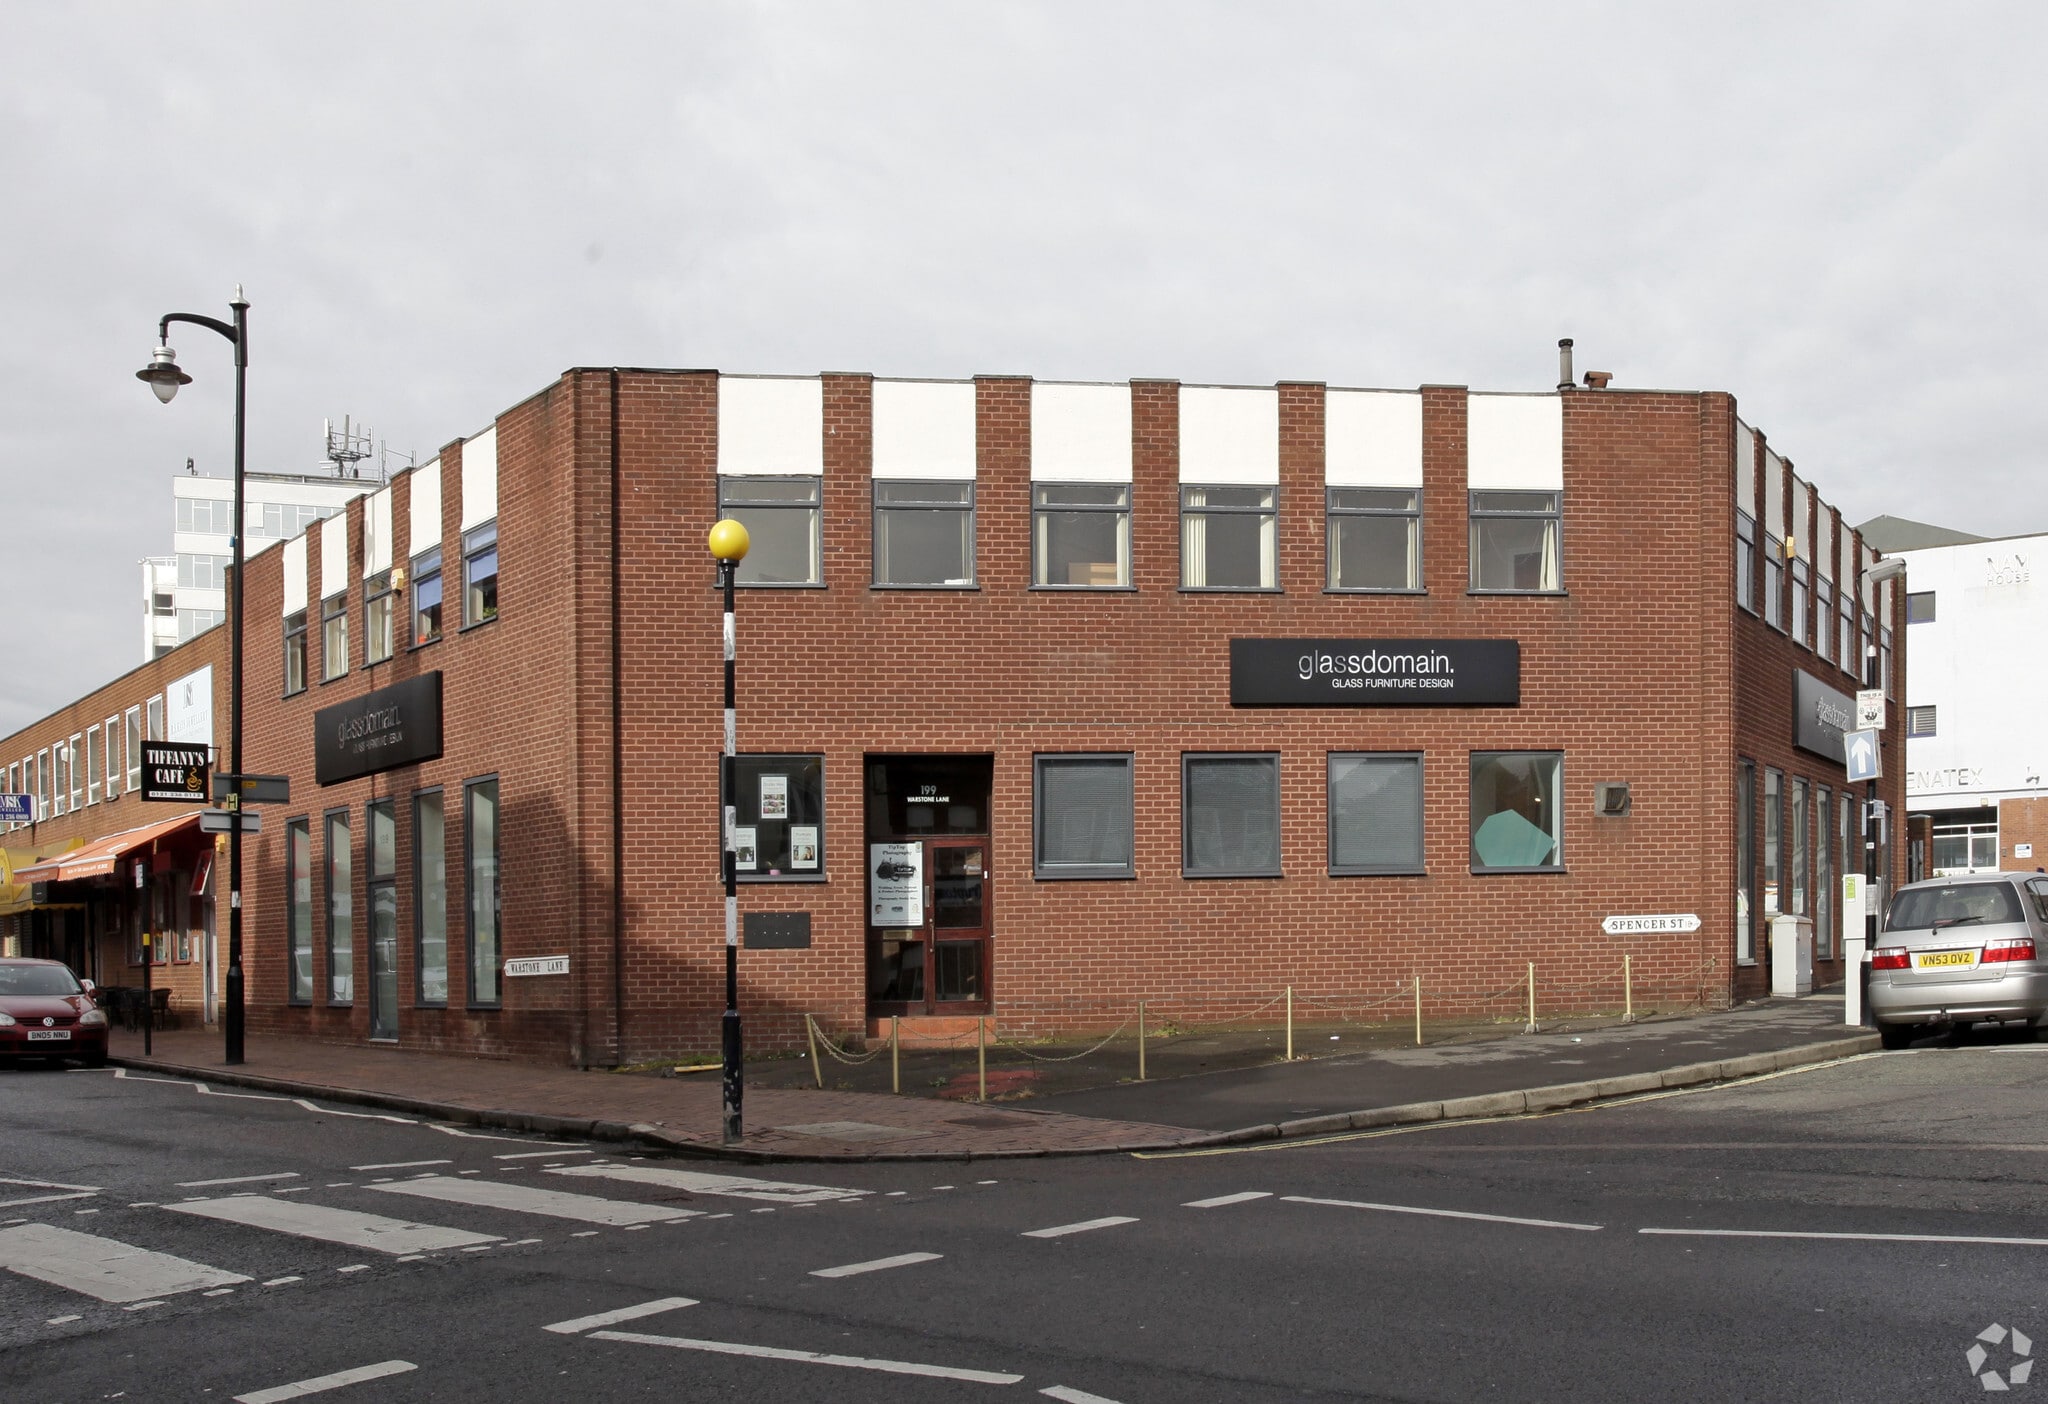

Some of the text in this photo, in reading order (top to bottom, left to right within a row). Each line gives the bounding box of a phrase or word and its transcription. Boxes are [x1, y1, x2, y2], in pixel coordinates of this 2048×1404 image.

[1987, 573, 2029, 585] HOUSE
[1298, 649, 1454, 680] glassdomain.
[1331, 678, 1454, 688] GLASS FURNITURE DESIGN
[147, 749, 204, 766] TIFFANY'S
[155, 765, 184, 784] CAFÉ
[920, 785, 937, 795] 199
[228, 794, 237, 809] H
[1612, 919, 1666, 930] SPENCER
[1670, 918, 1684, 928] ST
[1922, 952, 1970, 966] VN53 OVZ
[510, 960, 562, 973] WARSTONE LANE
[31, 1031, 69, 1039] BN05 NNU
